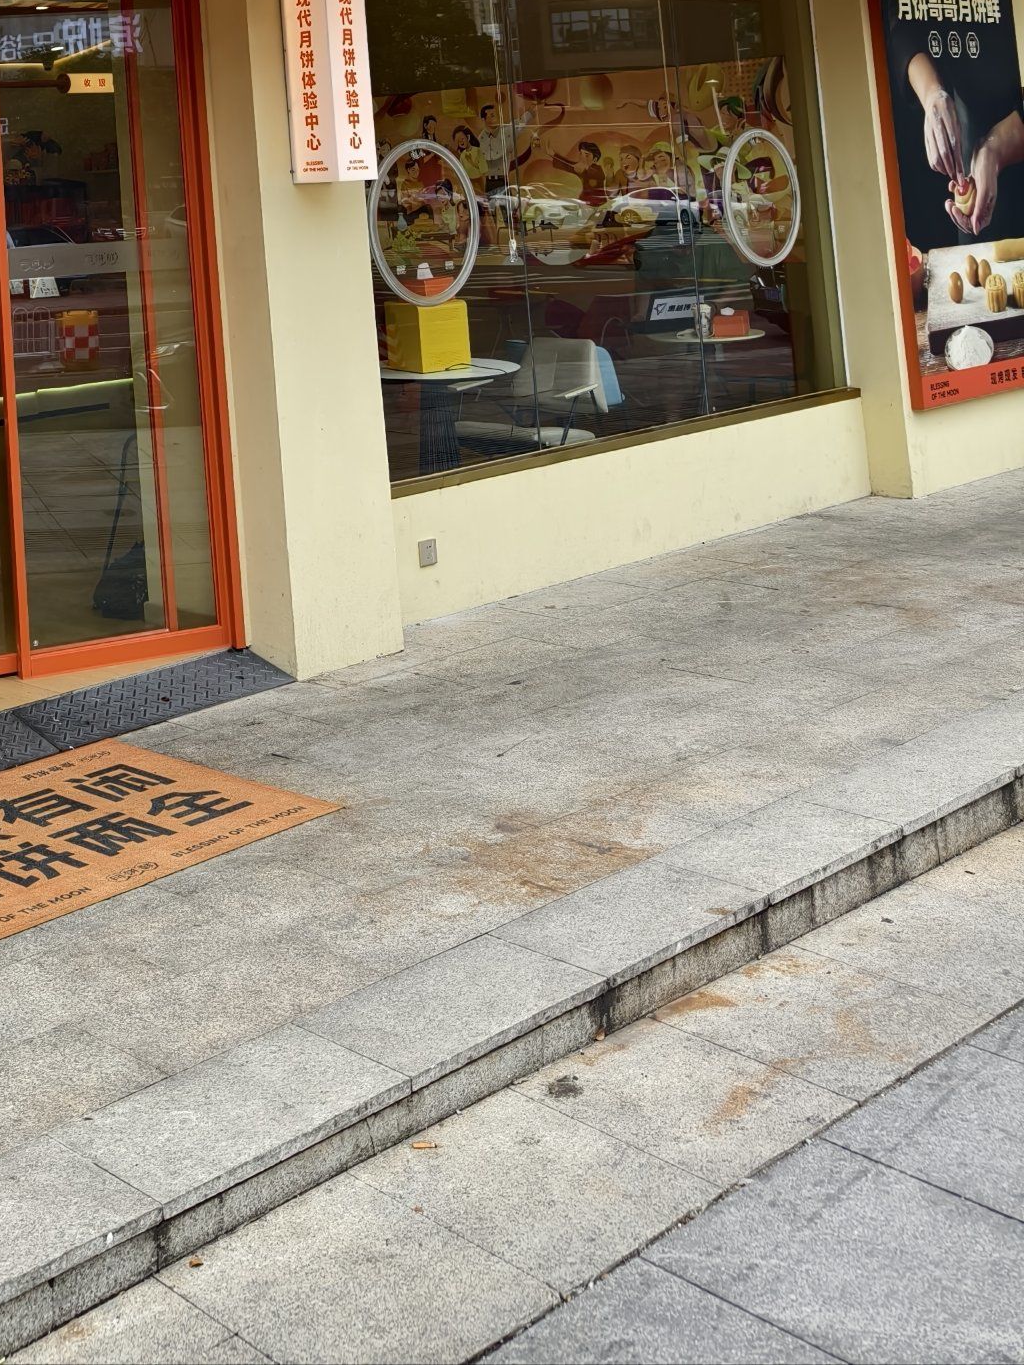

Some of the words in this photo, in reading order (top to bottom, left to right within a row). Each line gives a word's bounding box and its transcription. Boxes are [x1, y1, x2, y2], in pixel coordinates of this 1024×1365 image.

[930, 380, 950, 391] BLESSING
[932, 393, 937, 401] OF
[938, 391, 946, 399] THE
[947, 388, 960, 396] MOON
[170, 835, 229, 858] BLESSING
[229, 827, 246, 836] OF
[245, 818, 271, 829] THE
[270, 805, 308, 821] MOON
[17, 902, 49, 915] THE
[47, 886, 92, 905] MOON
